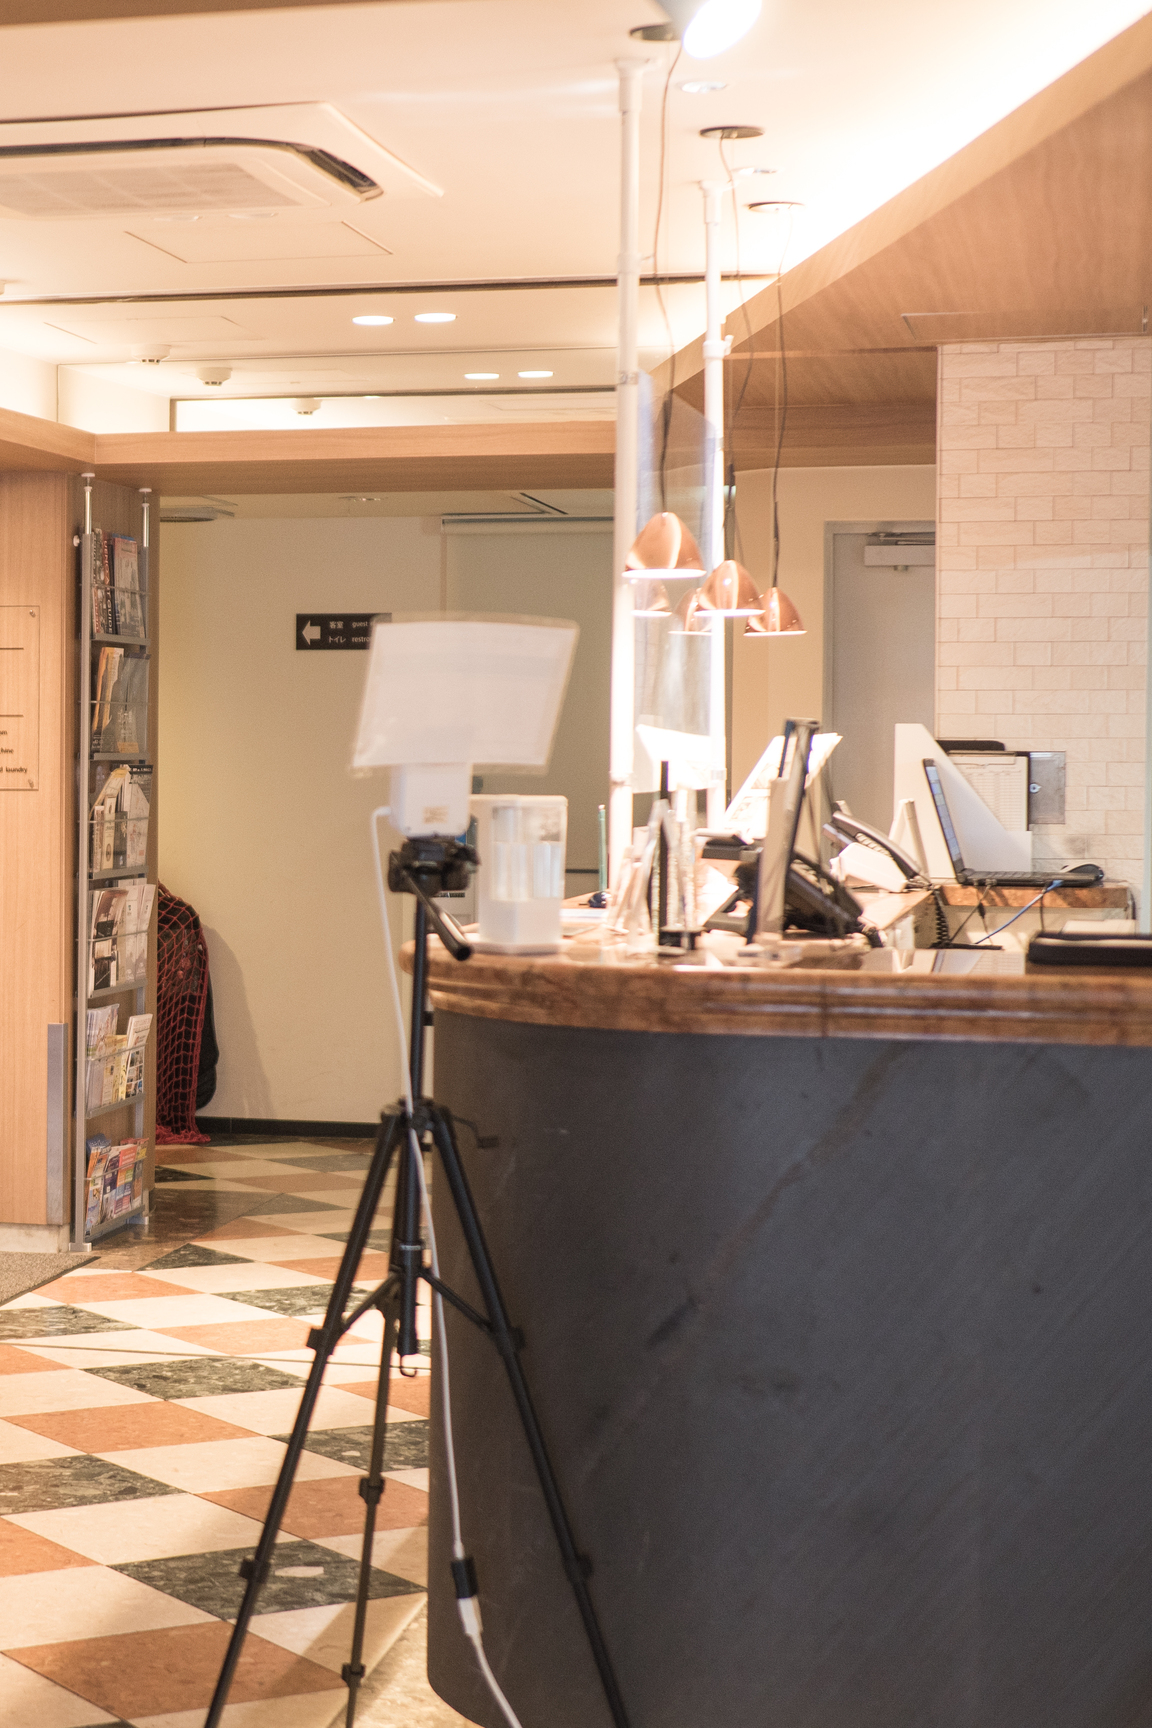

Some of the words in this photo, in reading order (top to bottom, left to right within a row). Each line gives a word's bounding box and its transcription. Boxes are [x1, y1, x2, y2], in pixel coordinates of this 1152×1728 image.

[328, 636, 346, 644] トイレ
[5, 766, 27, 774] laundry
